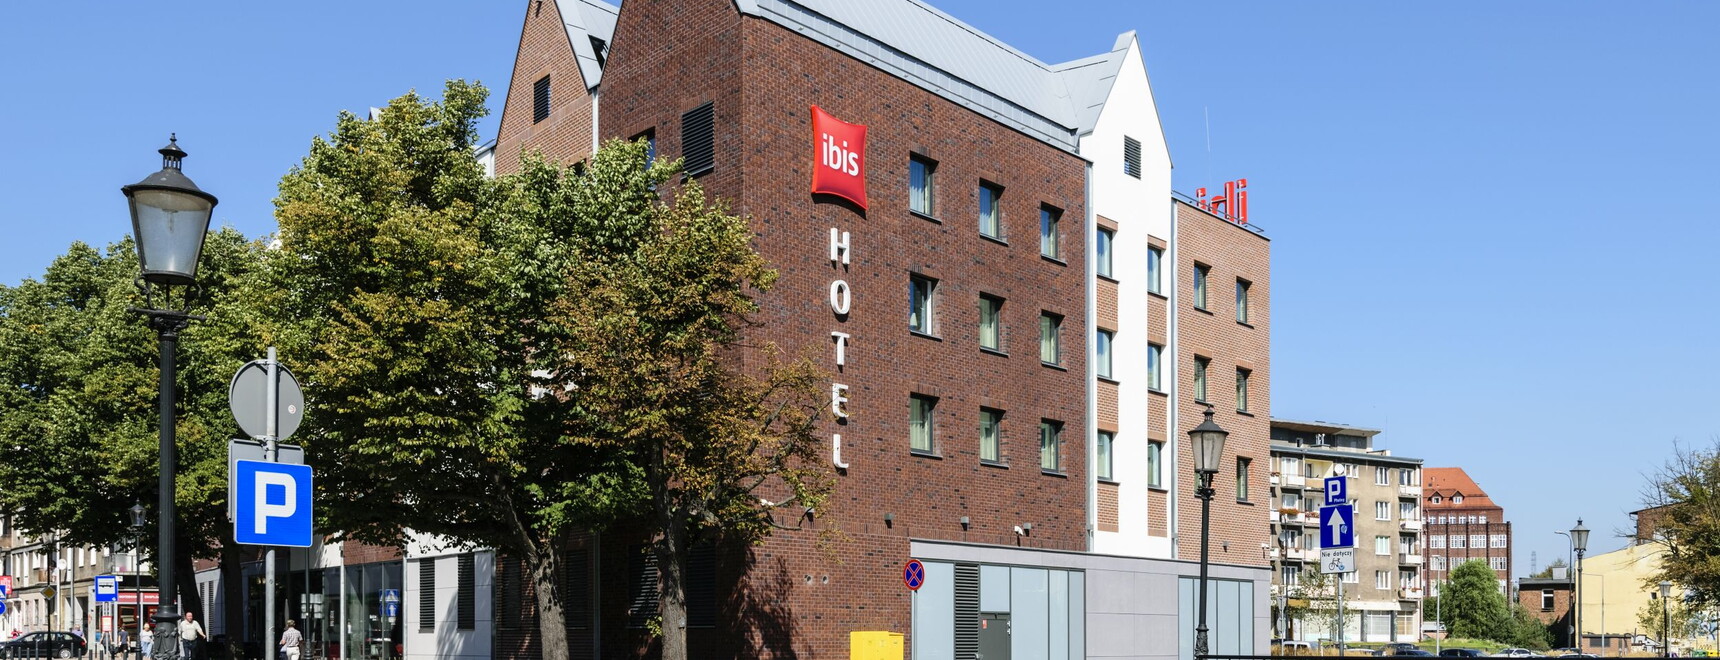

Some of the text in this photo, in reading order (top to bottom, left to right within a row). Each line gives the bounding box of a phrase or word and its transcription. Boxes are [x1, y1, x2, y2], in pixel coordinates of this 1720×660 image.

[822, 132, 859, 177] ibis
[829, 226, 851, 469] HOTEL
[254, 470, 297, 535] P
[1328, 480, 1341, 502] P
